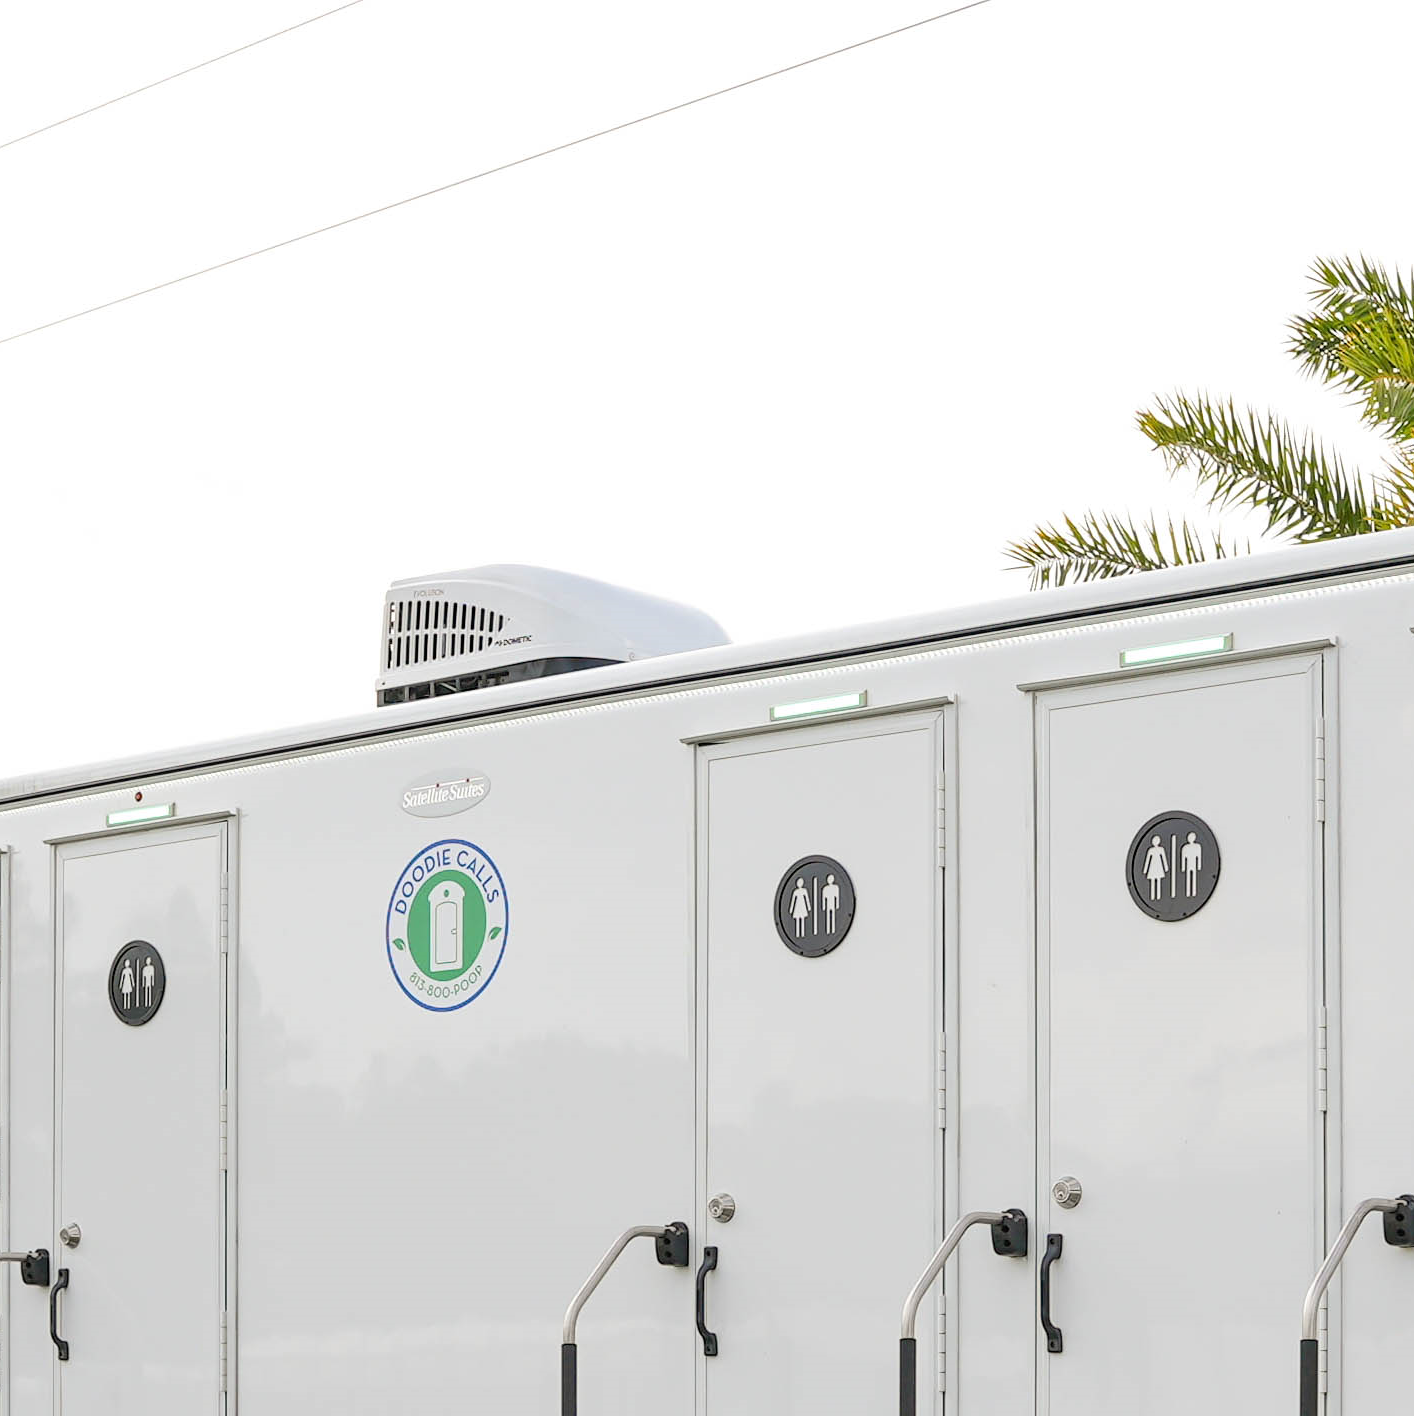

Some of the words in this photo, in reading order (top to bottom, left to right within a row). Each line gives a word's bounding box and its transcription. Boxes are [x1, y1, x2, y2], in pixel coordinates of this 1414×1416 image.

[394, 848, 452, 915] DOODIE
[456, 850, 500, 903] CALLS
[409, 964, 483, 999] 813-800-POOP
